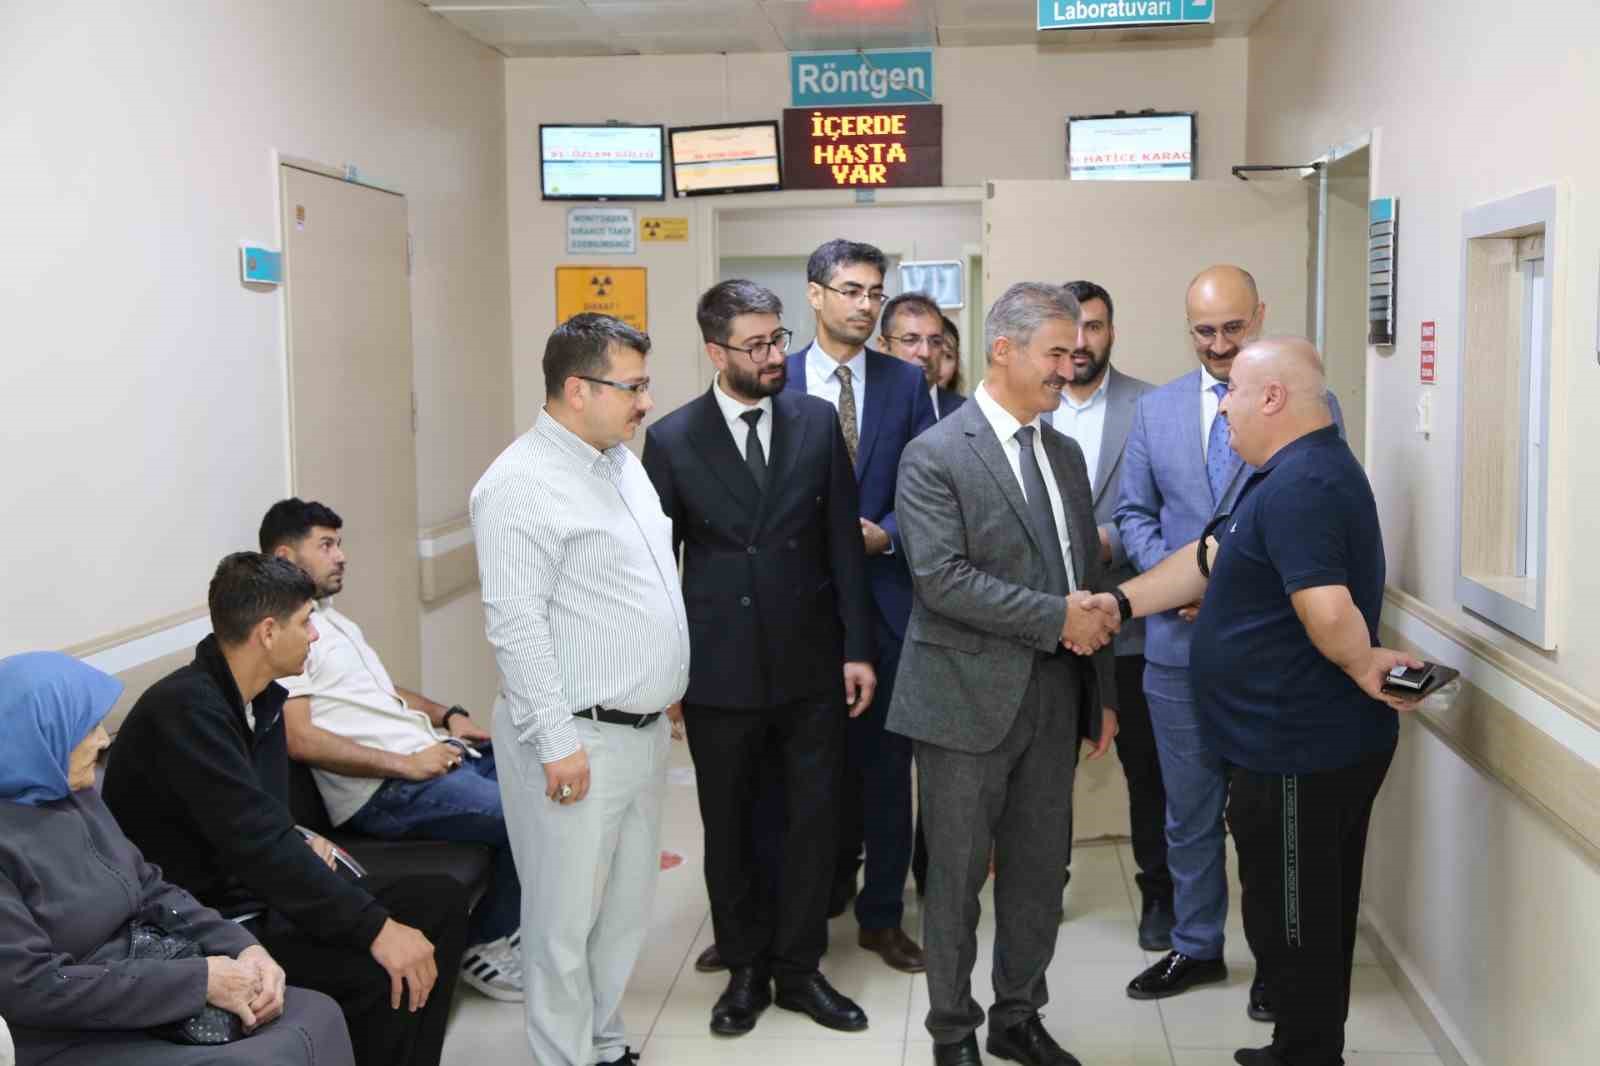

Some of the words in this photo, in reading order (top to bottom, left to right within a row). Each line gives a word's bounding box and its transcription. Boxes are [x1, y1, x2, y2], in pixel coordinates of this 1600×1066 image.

[798, 63, 925, 99] Röntgen
[811, 111, 907, 141] İÇERDE
[814, 143, 907, 165] HASTA
[831, 163, 887, 184] VAR
